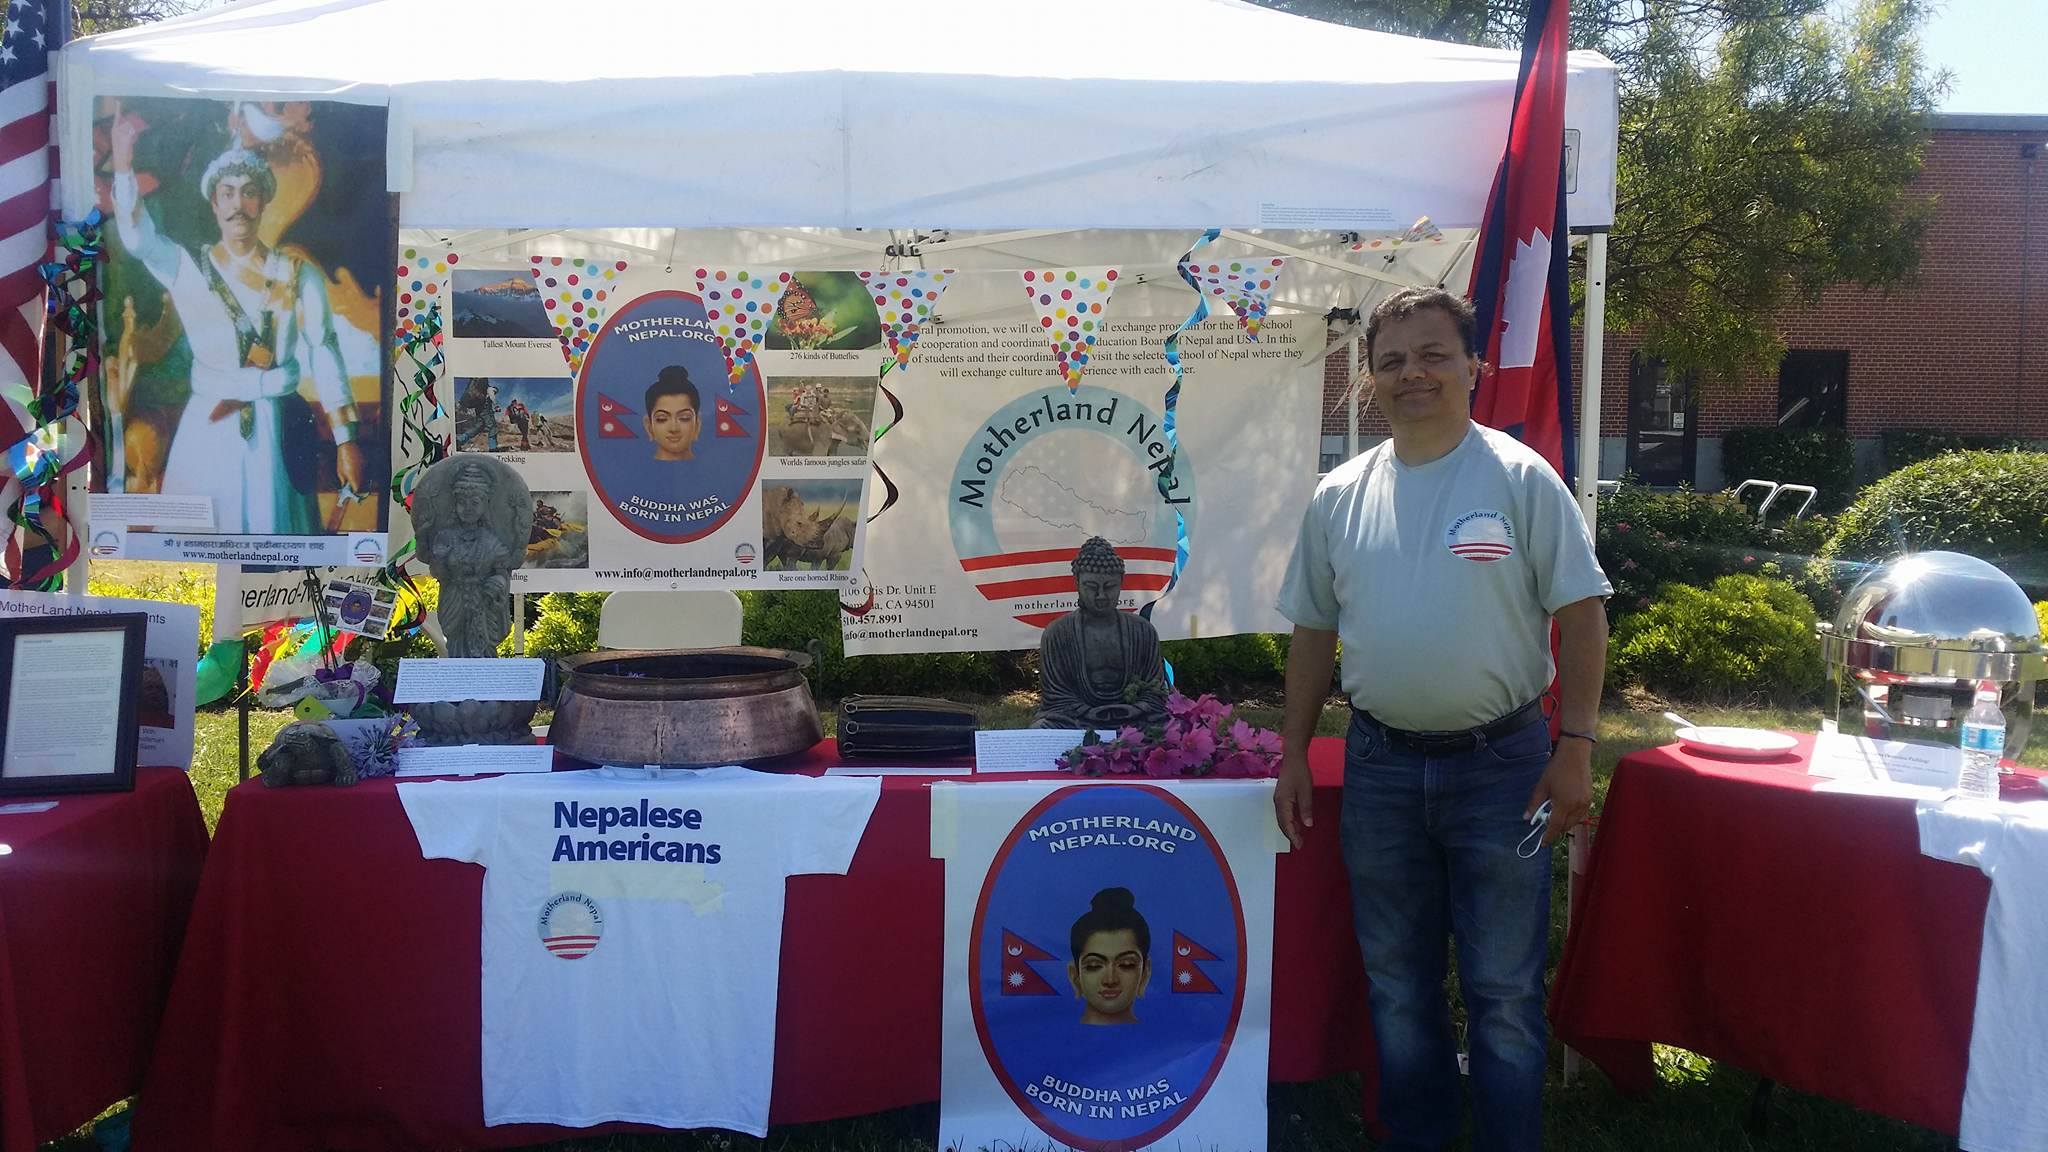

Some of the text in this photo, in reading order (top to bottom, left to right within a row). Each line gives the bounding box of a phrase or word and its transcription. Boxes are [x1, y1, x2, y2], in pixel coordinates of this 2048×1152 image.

[614, 316, 713, 334] MOTHERLAN
[937, 325, 990, 335] promotion,
[993, 326, 1008, 334] we
[1009, 324, 1028, 334] will
[1111, 323, 1157, 334] exchange
[1159, 323, 1200, 333] proam
[1203, 320, 1218, 331] for
[1219, 320, 1235, 330] the
[1261, 319, 1293, 329] school
[628, 329, 716, 343] NEPAL.ORG
[921, 338, 980, 349] cooperation
[981, 338, 999, 348] and
[1001, 338, 1050, 348] coordinati
[1096, 336, 1137, 346] ducation
[1185, 335, 1214, 347] Nepal
[1216, 335, 1234, 345] and
[1267, 334, 1277, 343] In
[1279, 333, 1297, 343] this
[483, 340, 503, 349] Tallest
[528, 341, 552, 349] Everest
[790, 352, 802, 360] 276
[803, 352, 820, 360] kinds
[821, 352, 829, 360] of
[912, 353, 923, 363] of
[924, 353, 964, 363] students
[967, 353, 985, 363] and
[987, 352, 1009, 362] their
[1011, 352, 1060, 362] coordina
[1091, 351, 1112, 361] visit
[1115, 351, 1130, 361] the
[1178, 350, 1205, 359] chool
[1208, 349, 1219, 359] of
[1221, 349, 1249, 361] Nepal
[1252, 349, 1282, 359] where
[1284, 348, 1304, 359] they
[940, 367, 959, 377] will
[961, 367, 1007, 379] exchange
[1009, 366, 1042, 377] culture
[1083, 365, 1118, 376] erience
[1120, 365, 1142, 375] with
[1144, 365, 1166, 374] each
[1169, 365, 1196, 374] oer.
[959, 394, 1191, 508] Motherland Nepal
[496, 455, 526, 464] Trekking
[804, 458, 827, 466] famous
[851, 458, 867, 466] safari
[630, 494, 719, 512] BUDDHA WAS
[618, 501, 732, 522] BORN IN NEPAL
[1448, 511, 1515, 539] Motherland Nepal
[183, 551, 299, 563] www.motherlandnepal.org
[595, 567, 757, 580] www.info@motherlandnepal.org
[830, 573, 849, 581] Rhino
[886, 585, 901, 595] Dr.
[904, 584, 926, 594] Unit
[929, 585, 936, 594] E
[0, 601, 72, 616] MotherLand
[886, 600, 902, 610] CA
[905, 600, 935, 609] 94501
[553, 798, 703, 834] Nepalese
[1028, 816, 1197, 842] MOTHERLAND
[552, 832, 722, 864] Americans
[1050, 833, 1177, 854] NEPAL.ORG
[540, 893, 602, 926] Motherland Nepal
[1042, 1075, 1170, 1102] BUDDHA WAS
[1025, 1083, 1188, 1119] BORN IN NEPAL
